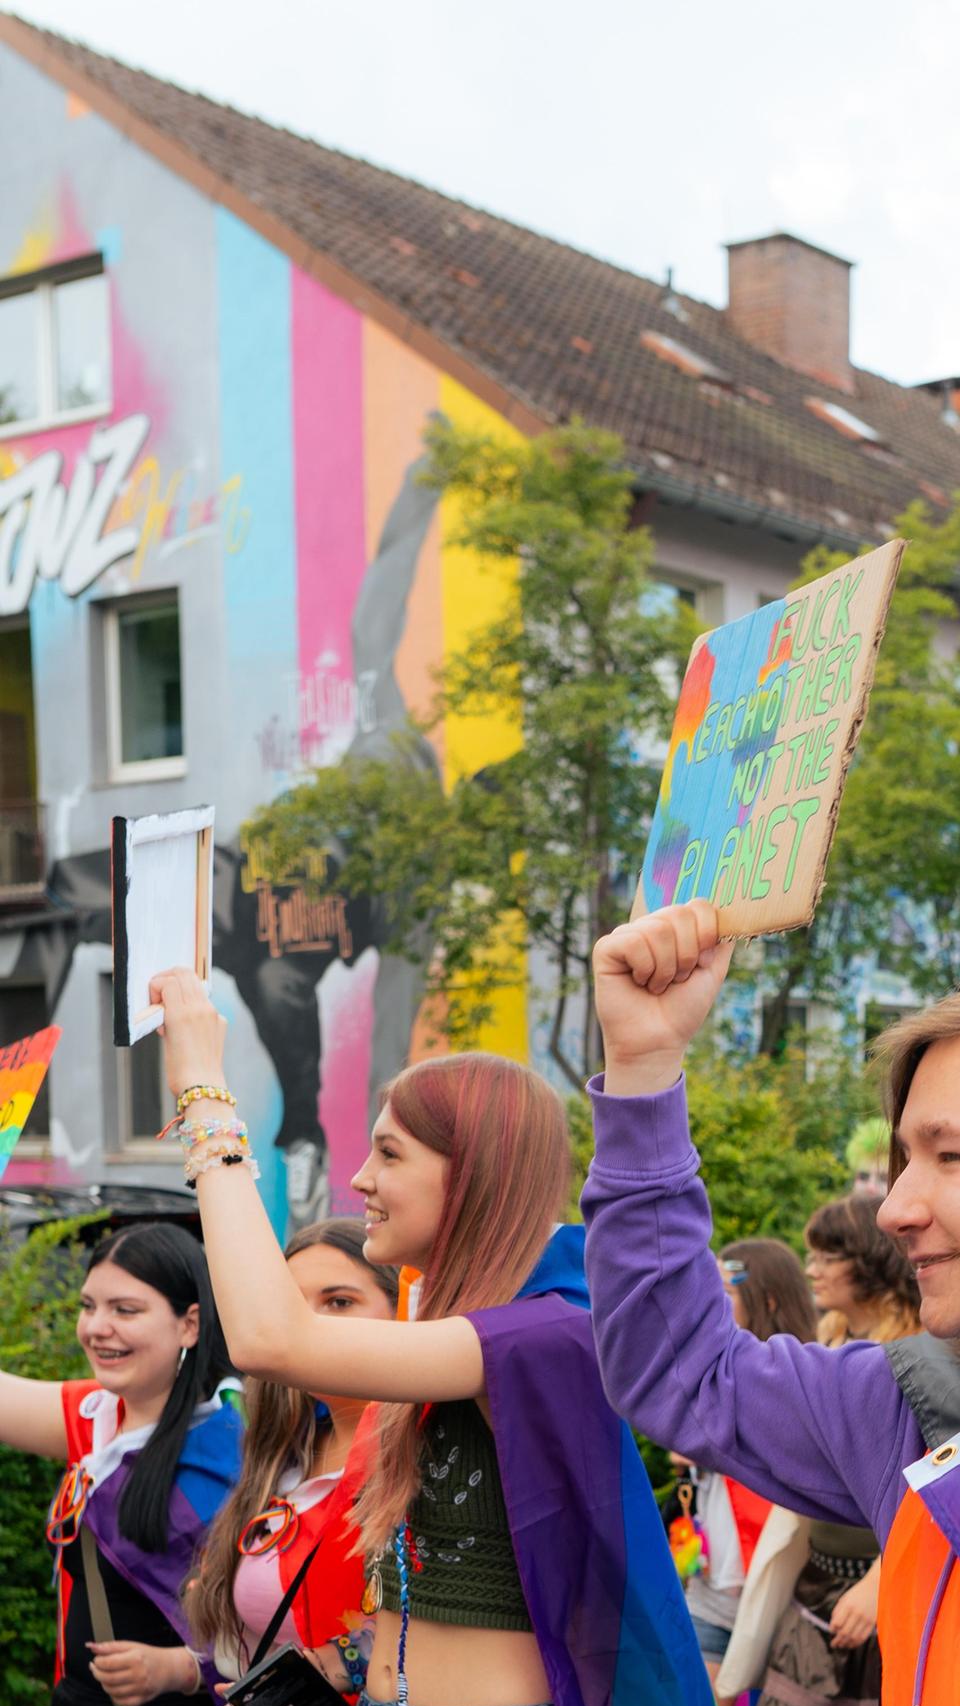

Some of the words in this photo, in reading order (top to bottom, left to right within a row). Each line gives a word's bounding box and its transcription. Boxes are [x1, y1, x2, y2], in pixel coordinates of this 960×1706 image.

[769, 569, 865, 661] FUCK
[695, 684, 765, 764] EACH
[761, 632, 862, 734] OTHER
[727, 744, 784, 808] NOT
[783, 718, 839, 794] THE
[672, 796, 820, 908] PLANET
